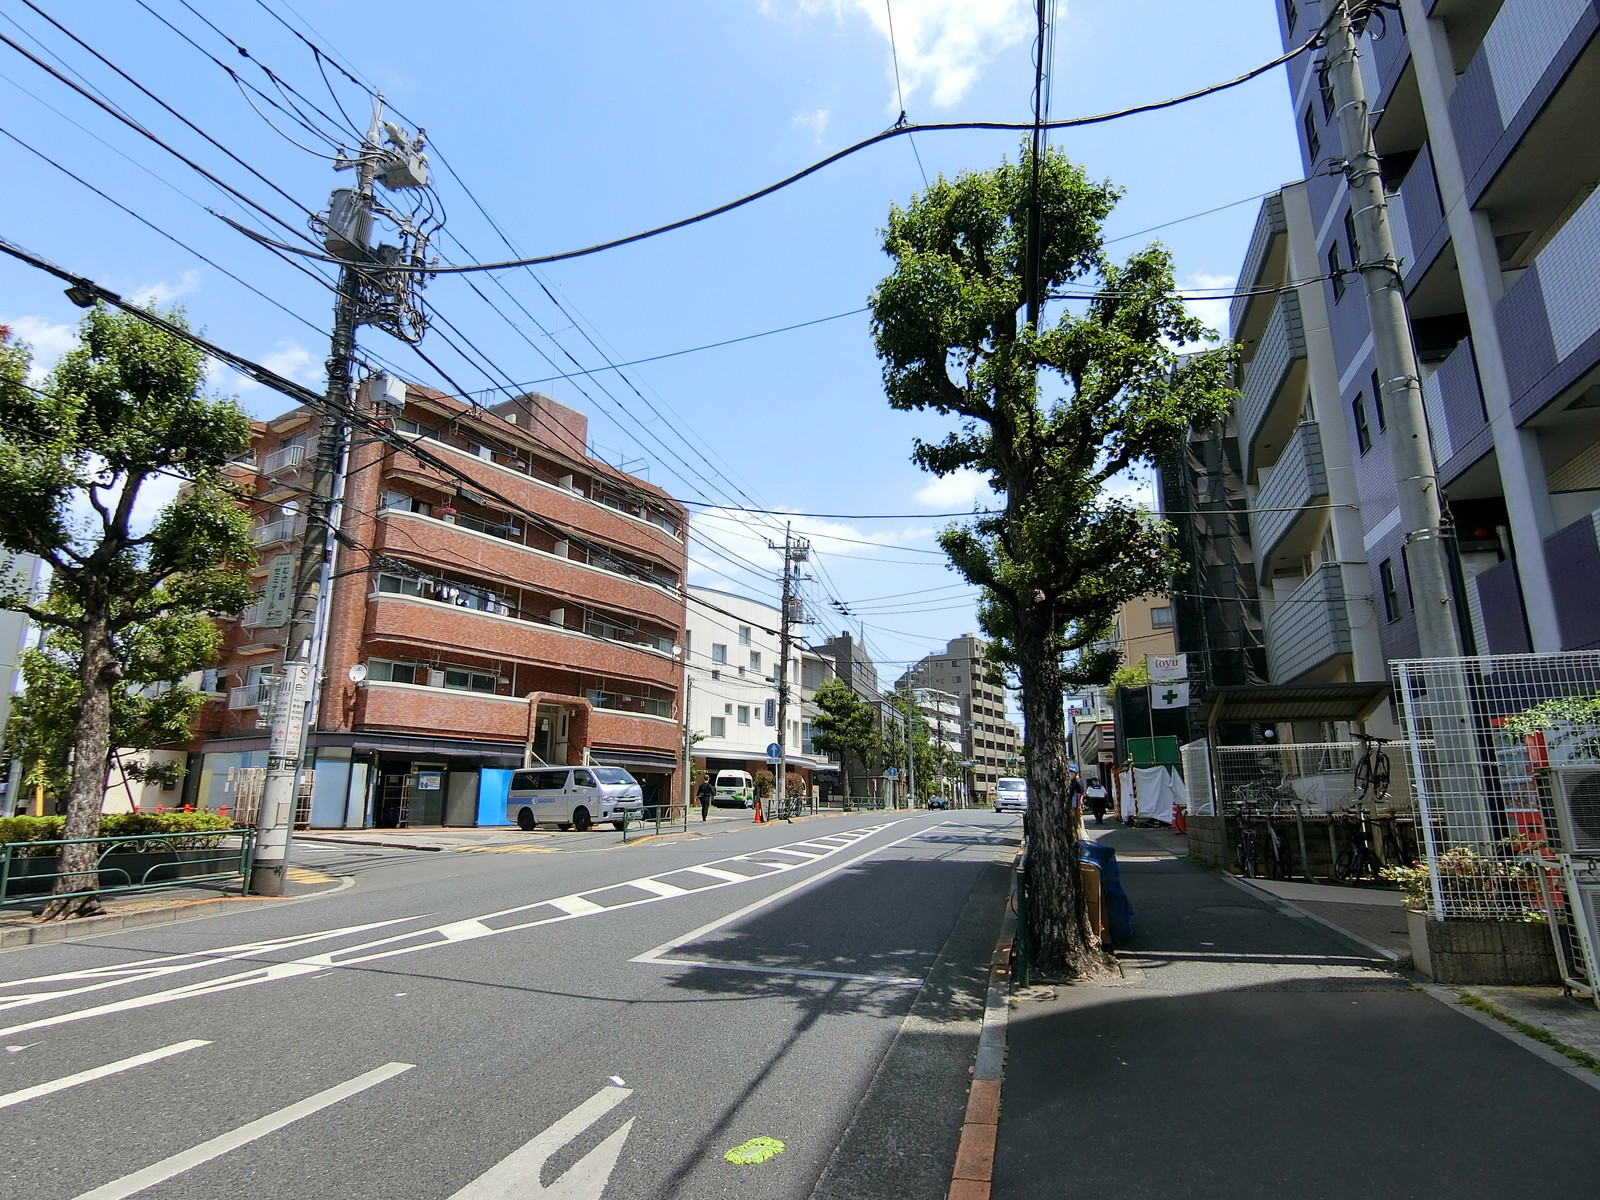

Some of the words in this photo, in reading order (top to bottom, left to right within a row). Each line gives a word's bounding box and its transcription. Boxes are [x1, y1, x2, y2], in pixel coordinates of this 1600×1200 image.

[268, 567, 281, 610] ゼミナール
[278, 567, 290, 600] むさし野
